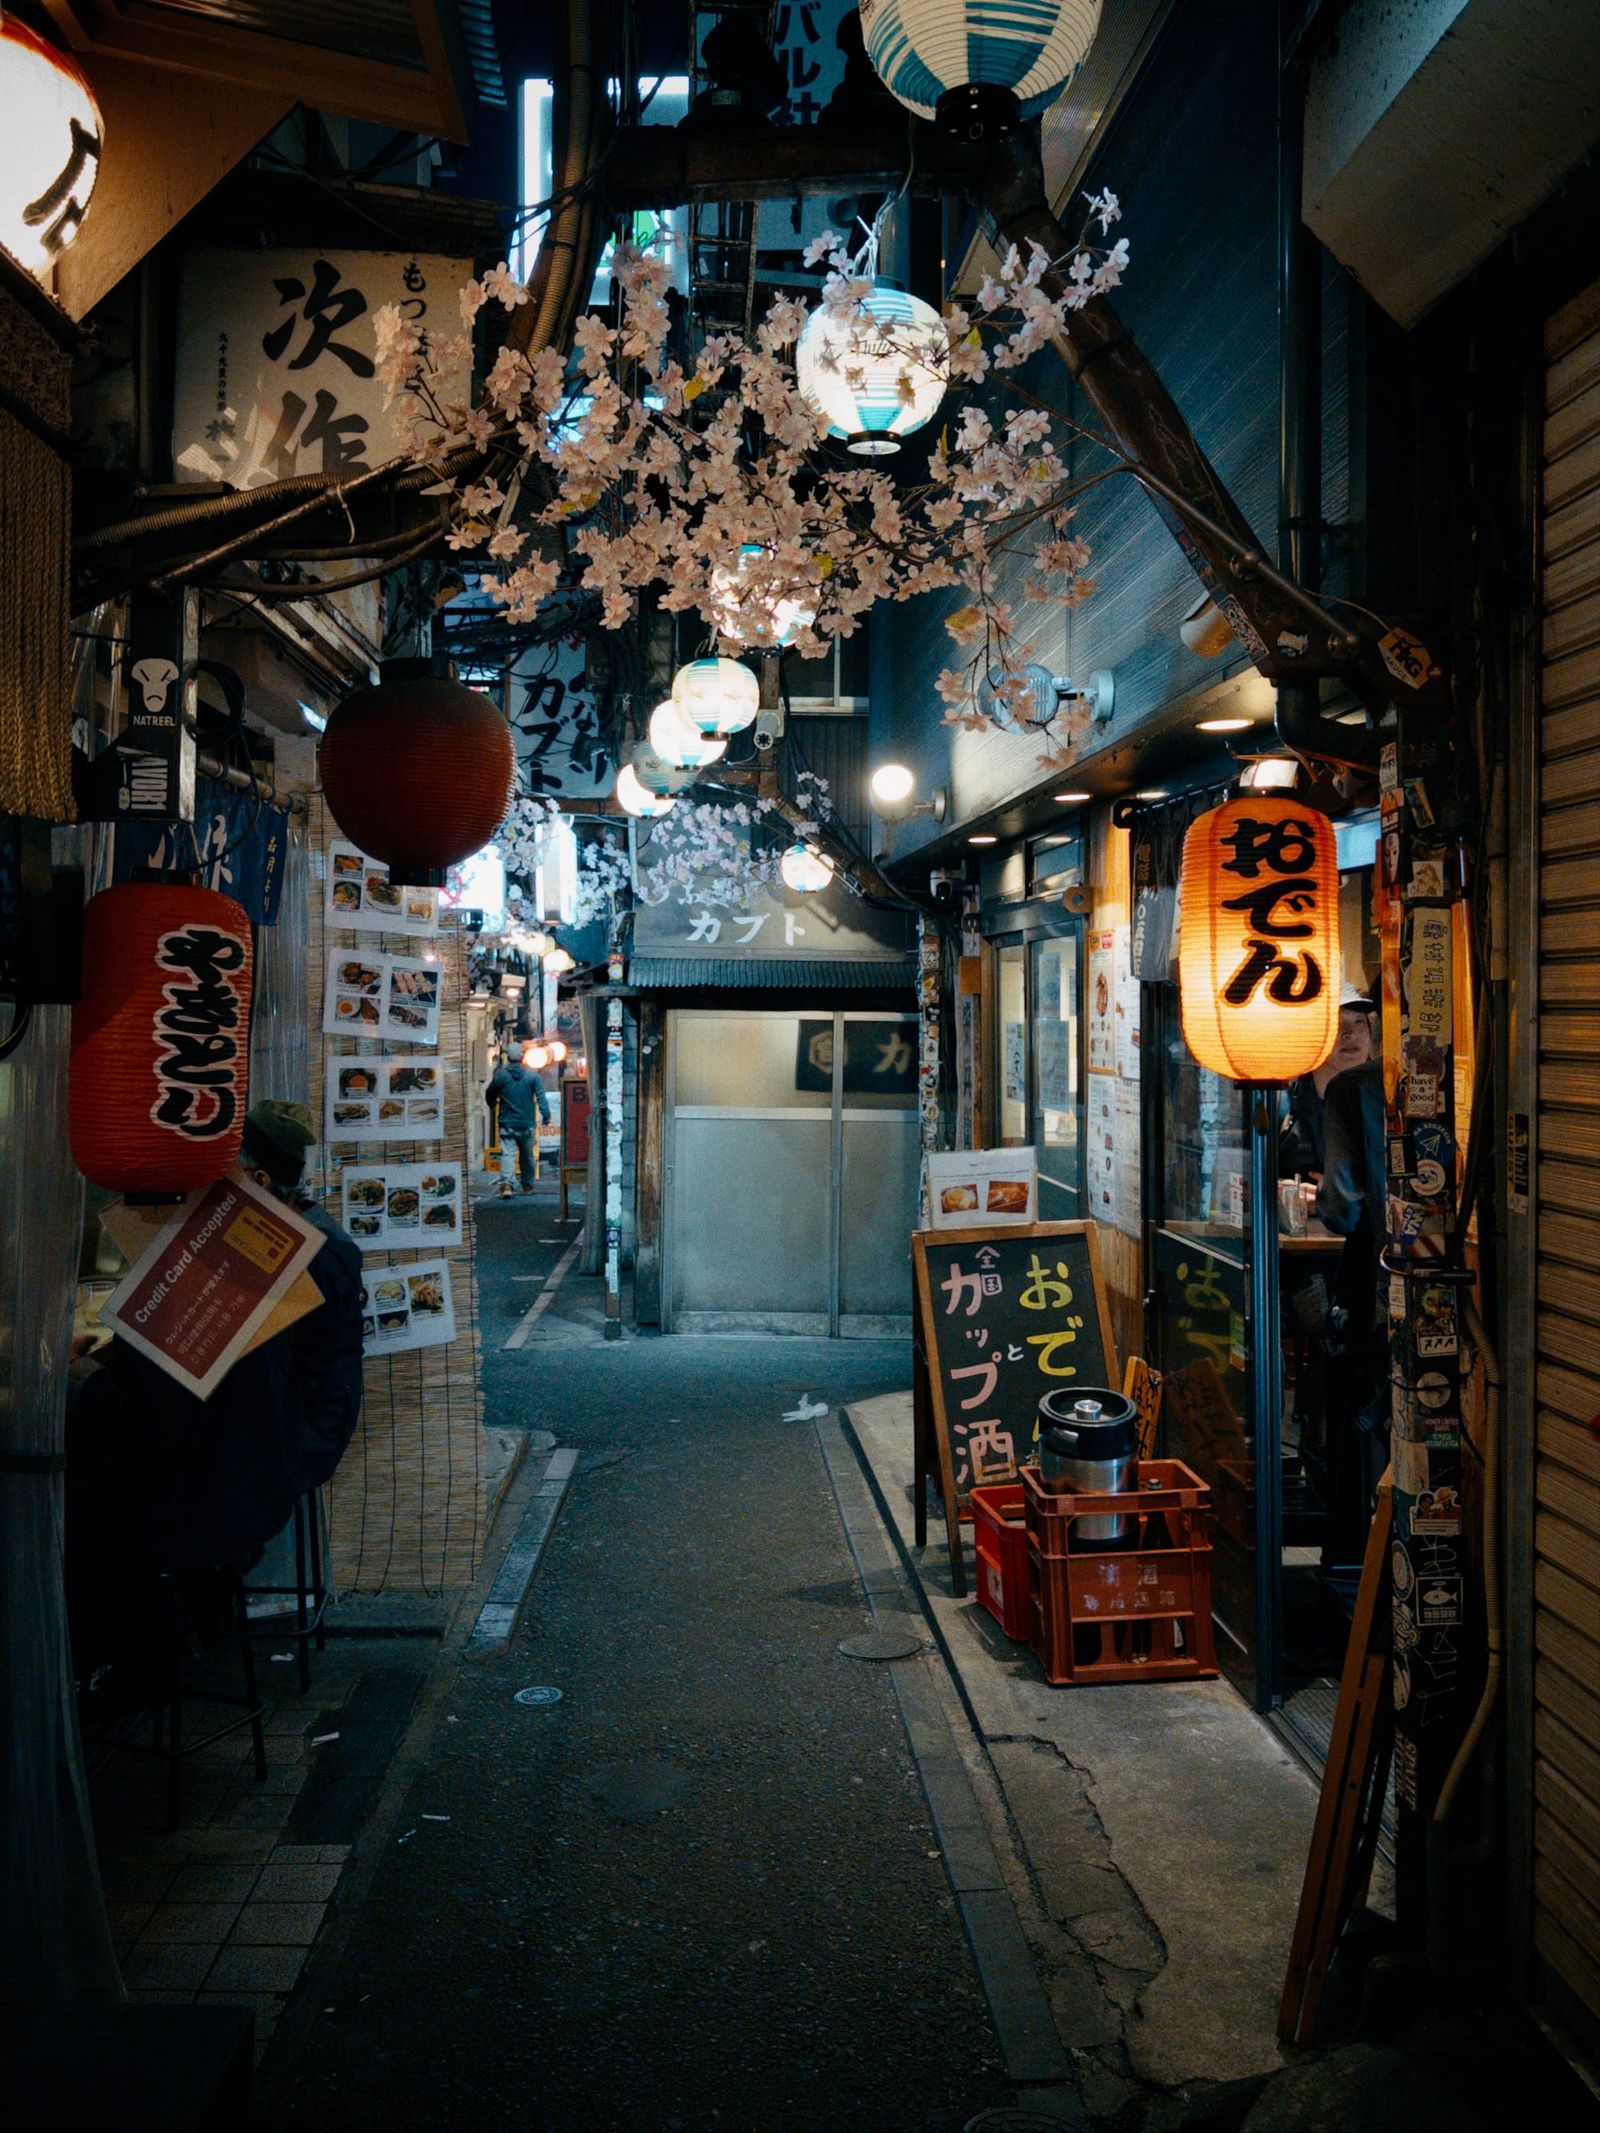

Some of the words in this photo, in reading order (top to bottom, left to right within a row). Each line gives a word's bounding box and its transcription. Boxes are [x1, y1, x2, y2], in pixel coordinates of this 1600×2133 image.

[132, 714, 176, 727] NATREEL
[686, 910, 806, 946] カブト
[1219, 817, 1323, 1005] おでん
[155, 928, 245, 1137] やきとり
[134, 1282, 170, 1324] Credit
[163, 1250, 194, 1284] Card
[189, 1193, 237, 1254] Accepted
[975, 1246, 1003, 1296] 全国
[941, 1263, 1018, 1486] カップ酒
[1007, 1344, 1025, 1362] と
[1019, 1254, 1084, 1442] おで
